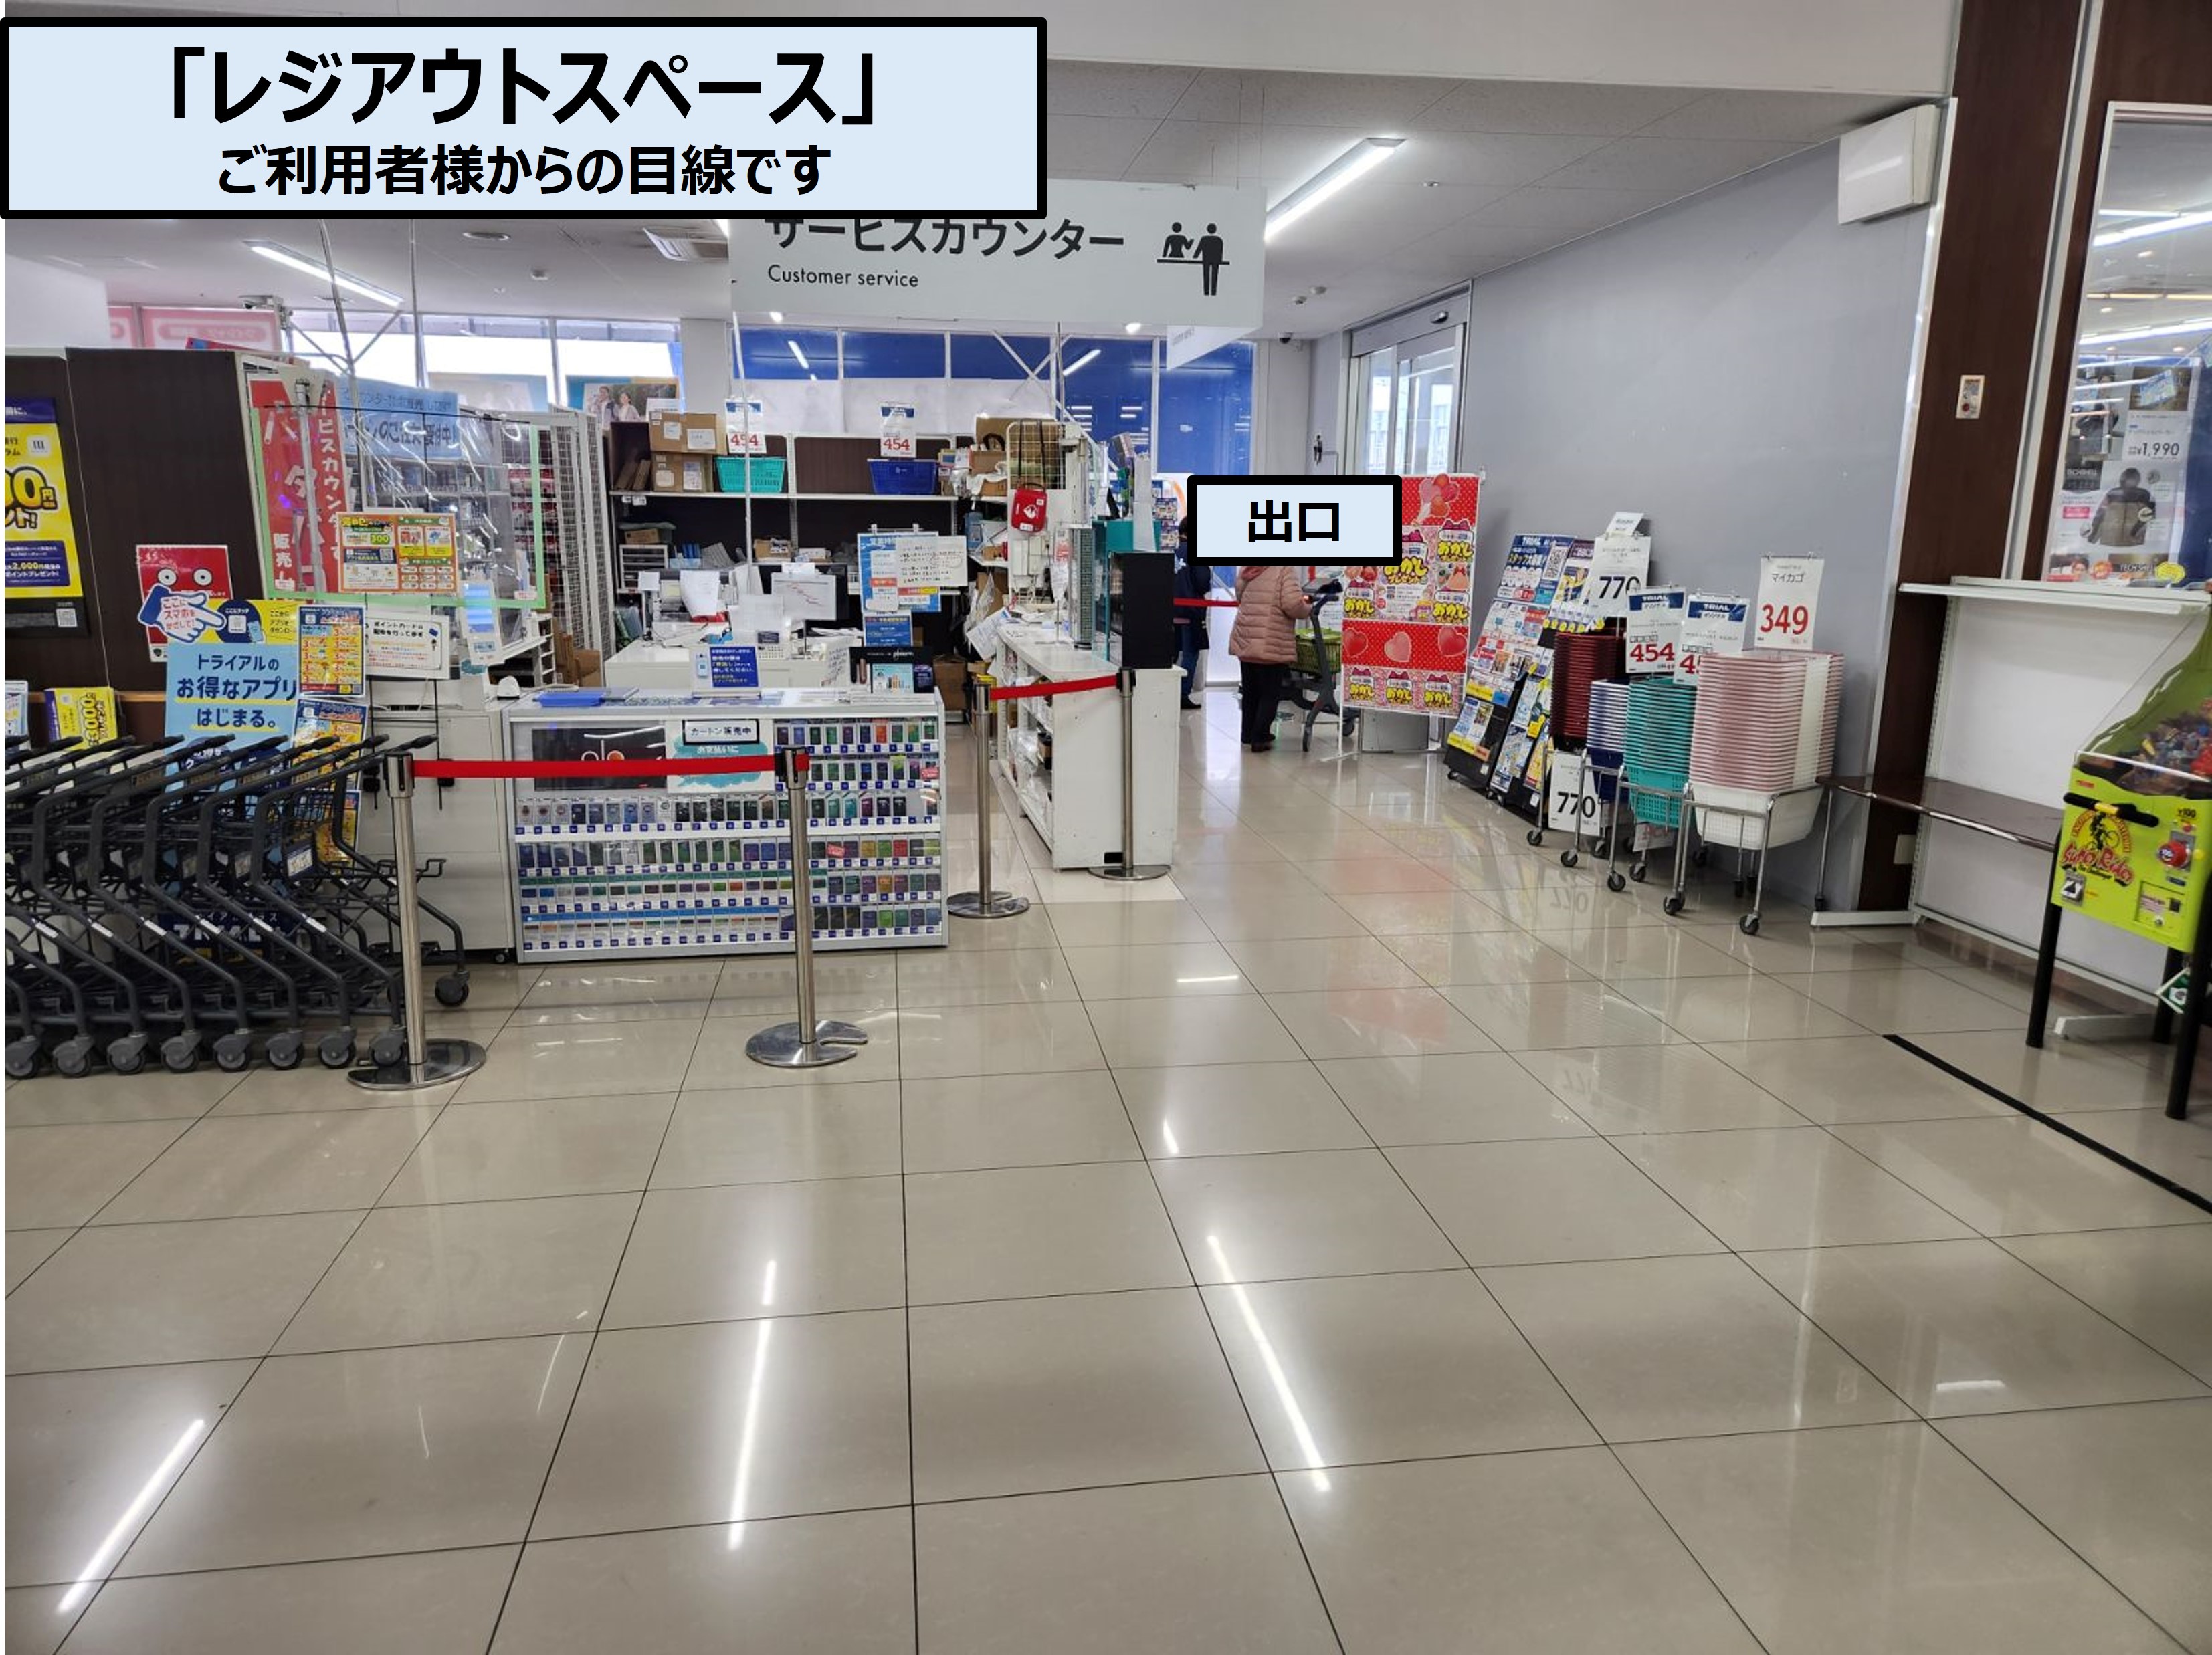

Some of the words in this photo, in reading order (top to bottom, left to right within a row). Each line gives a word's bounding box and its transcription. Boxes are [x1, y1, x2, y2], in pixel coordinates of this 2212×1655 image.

[768, 265, 851, 284] Customer
[858, 270, 918, 287] service
[883, 438, 910, 451] 454
[1438, 541, 1474, 558] おかし
[1771, 573, 1805, 583] マイカゴ
[1599, 576, 1641, 599] 770
[164, 609, 195, 620] スマホを
[1344, 598, 1375, 615] おかし
[1433, 602, 1469, 619] おかし
[1759, 603, 1809, 635] 349
[1629, 642, 1676, 663] 454
[199, 654, 280, 671] トライアルの
[1679, 654, 1700, 674] 4
[177, 675, 296, 701] お得なアプリ
[197, 708, 276, 728] はじまる。
[690, 726, 752, 736] カートン販売中
[1557, 791, 1596, 818] 770
